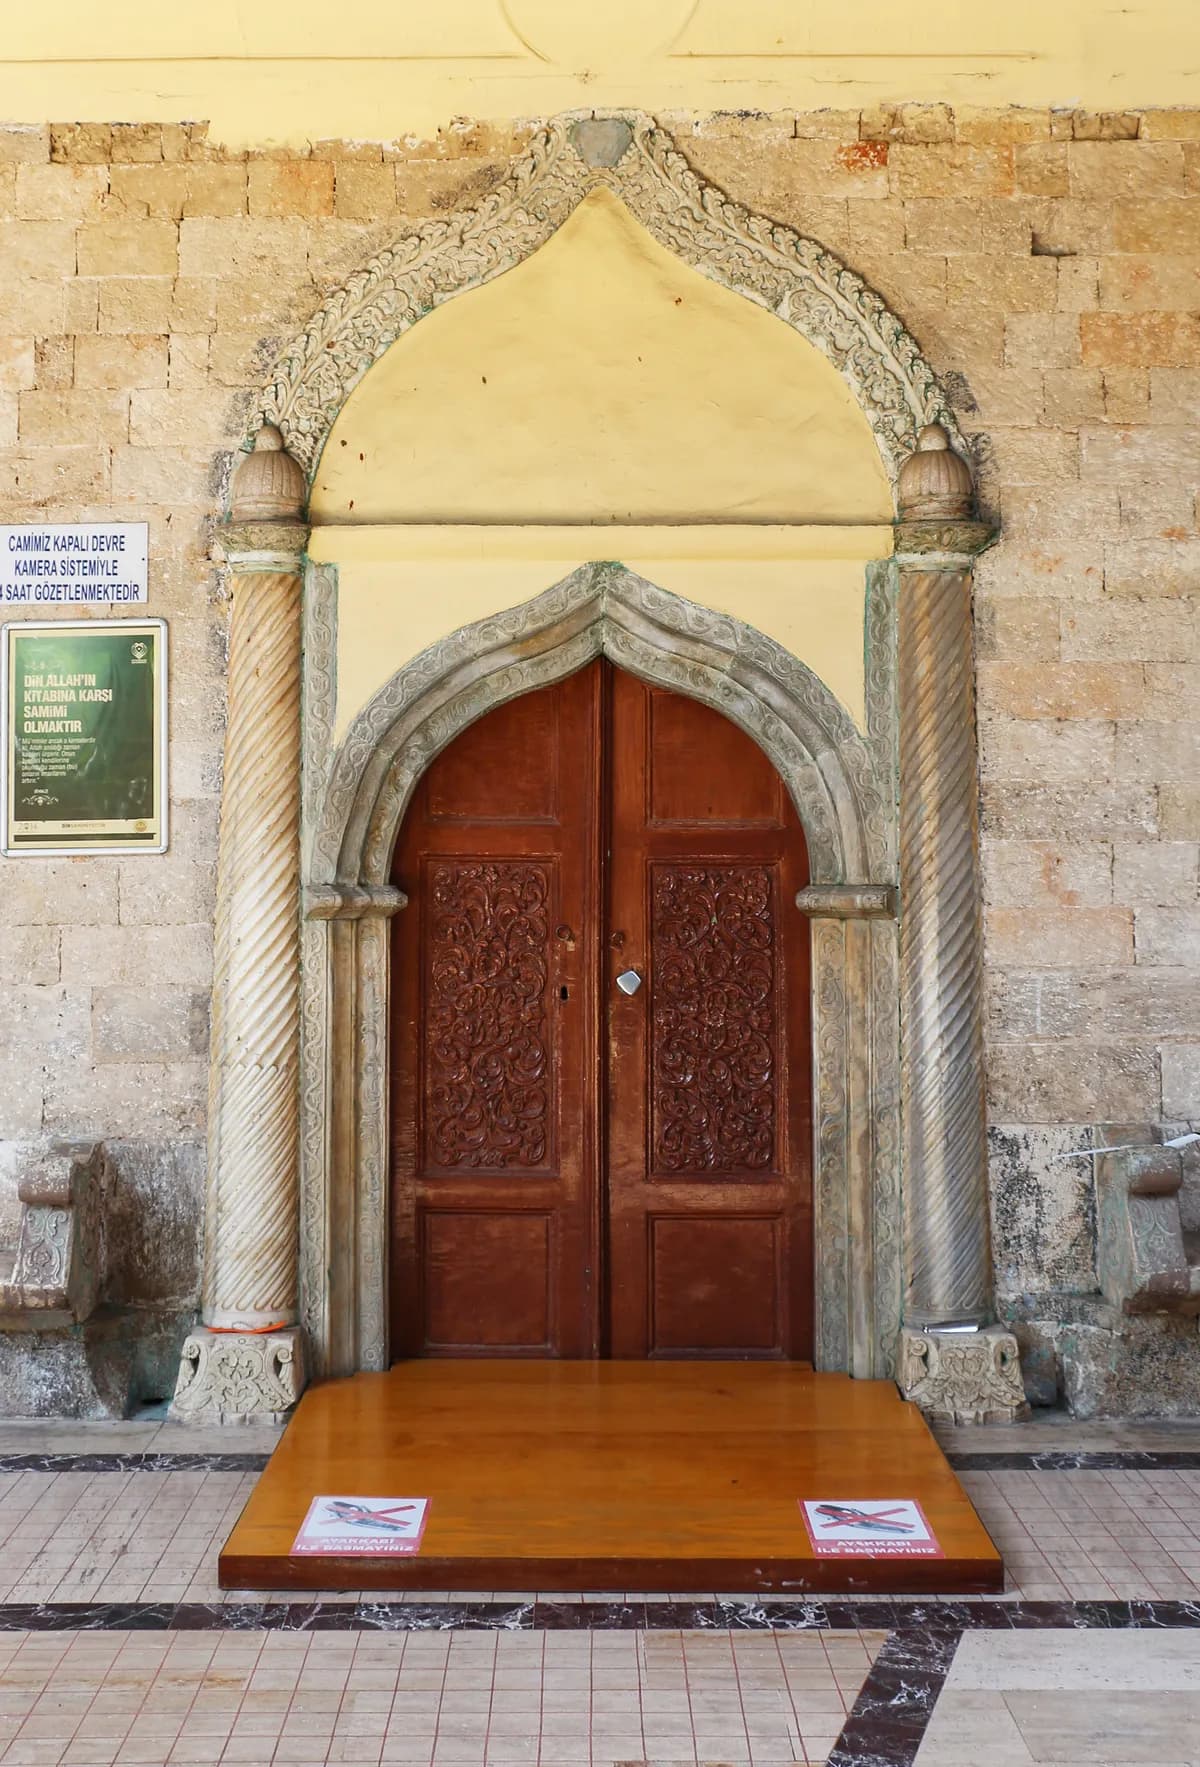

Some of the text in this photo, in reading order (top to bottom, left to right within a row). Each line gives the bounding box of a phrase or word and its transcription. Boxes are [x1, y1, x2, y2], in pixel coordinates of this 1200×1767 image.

[8, 532, 126, 552] CAMİMİZ KAPALI DEVRE
[14, 556, 119, 576] KAMERA SİSTEMİYLE
[6, 584, 32, 601] SAAT
[35, 580, 140, 600] GÖZETLENMEKTEDİR
[79, 689, 113, 703] KARŞI
[24, 705, 68, 718] SAMİMİ
[24, 720, 82, 734] OLMAKTIR
